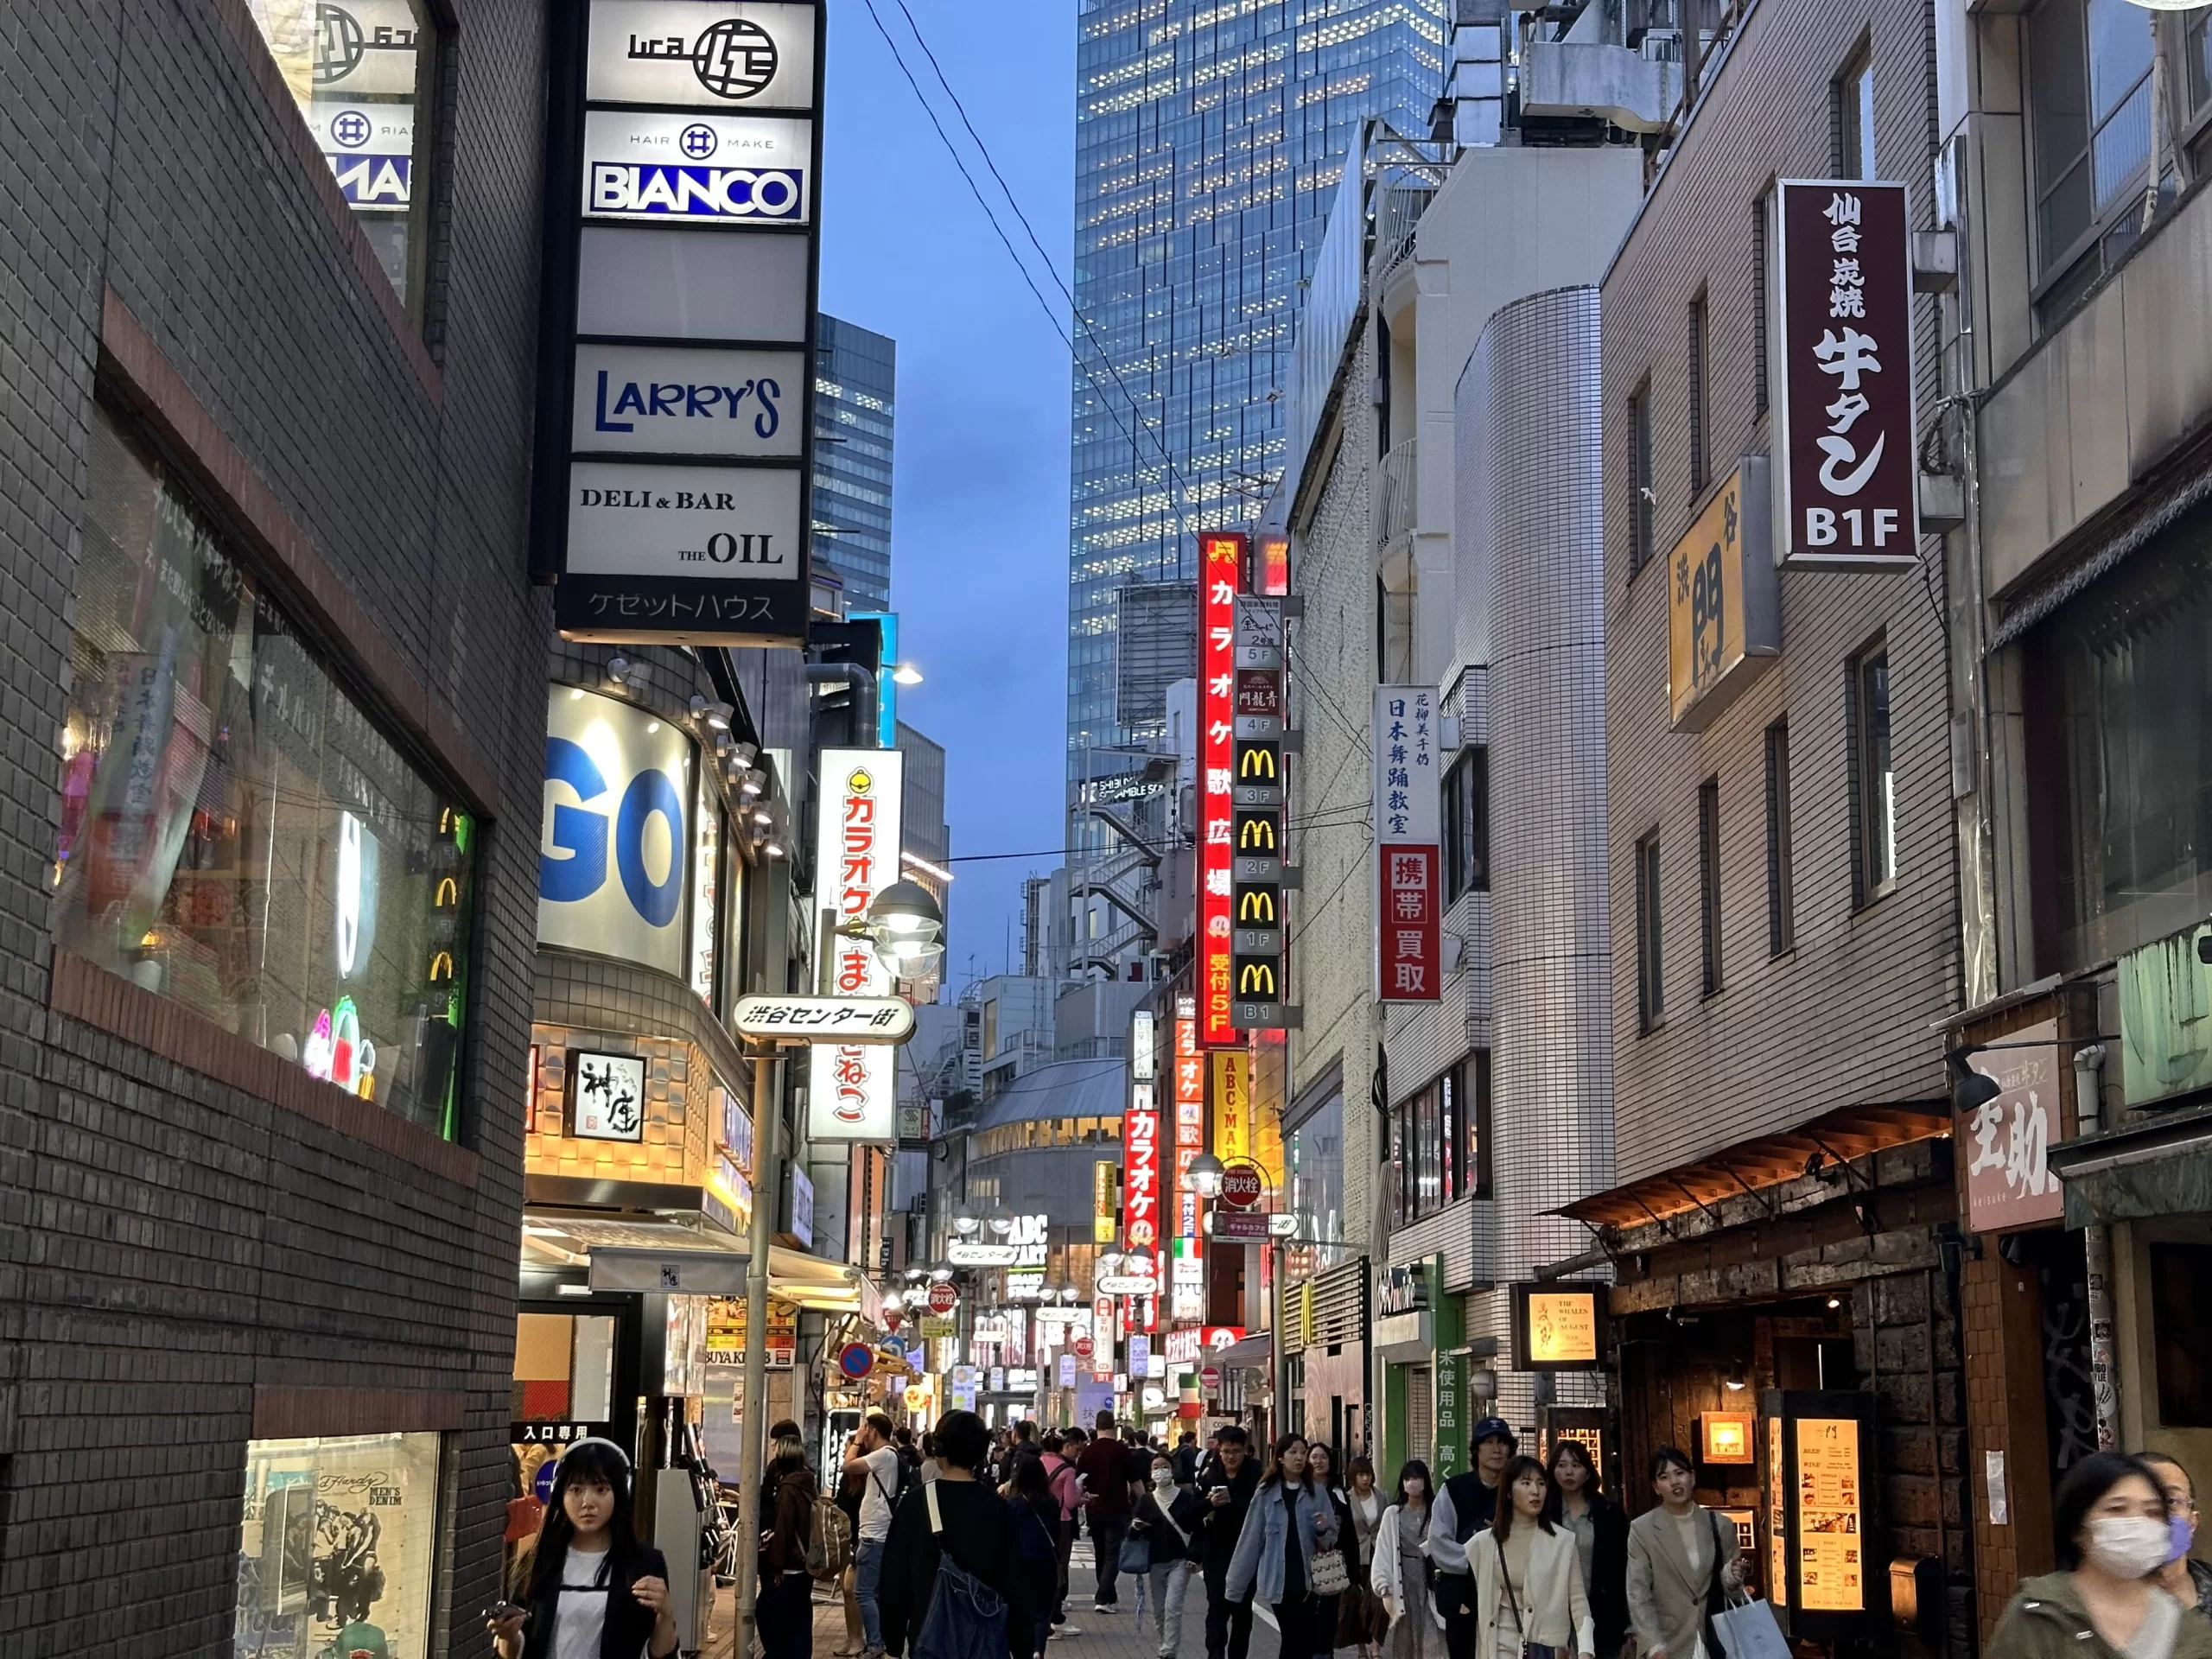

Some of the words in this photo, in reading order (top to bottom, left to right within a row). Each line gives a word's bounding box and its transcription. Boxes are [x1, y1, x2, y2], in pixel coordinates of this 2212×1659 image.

[631, 135, 670, 144] HAIR
[728, 139, 774, 149] MAKE
[594, 165, 798, 216] BIANCO
[1823, 193, 1866, 319] 仙台炭焼
[595, 370, 780, 439] LARRY'S
[1813, 327, 1884, 496] 牛タン
[581, 489, 652, 508] DELI
[656, 498, 671, 509] &
[676, 492, 735, 511] BAR
[1807, 508, 1899, 546] B1F
[678, 550, 706, 562] THE
[708, 532, 783, 563] OIL
[588, 593, 773, 620] ケゼットハウス
[1388, 699, 1408, 835] 日本舞踊教室
[843, 796, 874, 914] カラオケ
[1395, 857, 1426, 993] 携帯買取
[1210, 954, 1230, 1031] 受付5F
[743, 1005, 899, 1026] 渋谷センター街
[1244, 1005, 1268, 1020] B1
[1180, 1021, 1198, 1097] カラオケ
[1129, 1111, 1155, 1217] カラオケ
[1224, 1177, 1258, 1192] 消火栓
[1007, 1214, 1048, 1244] ABC
[930, 1294, 954, 1305] 消火栓
[1439, 1349, 1455, 1427] 未使用品
[524, 1425, 588, 1440] 入口専用
[369, 1497, 403, 1505] DENIM
[370, 1486, 401, 1496] MEN'S
